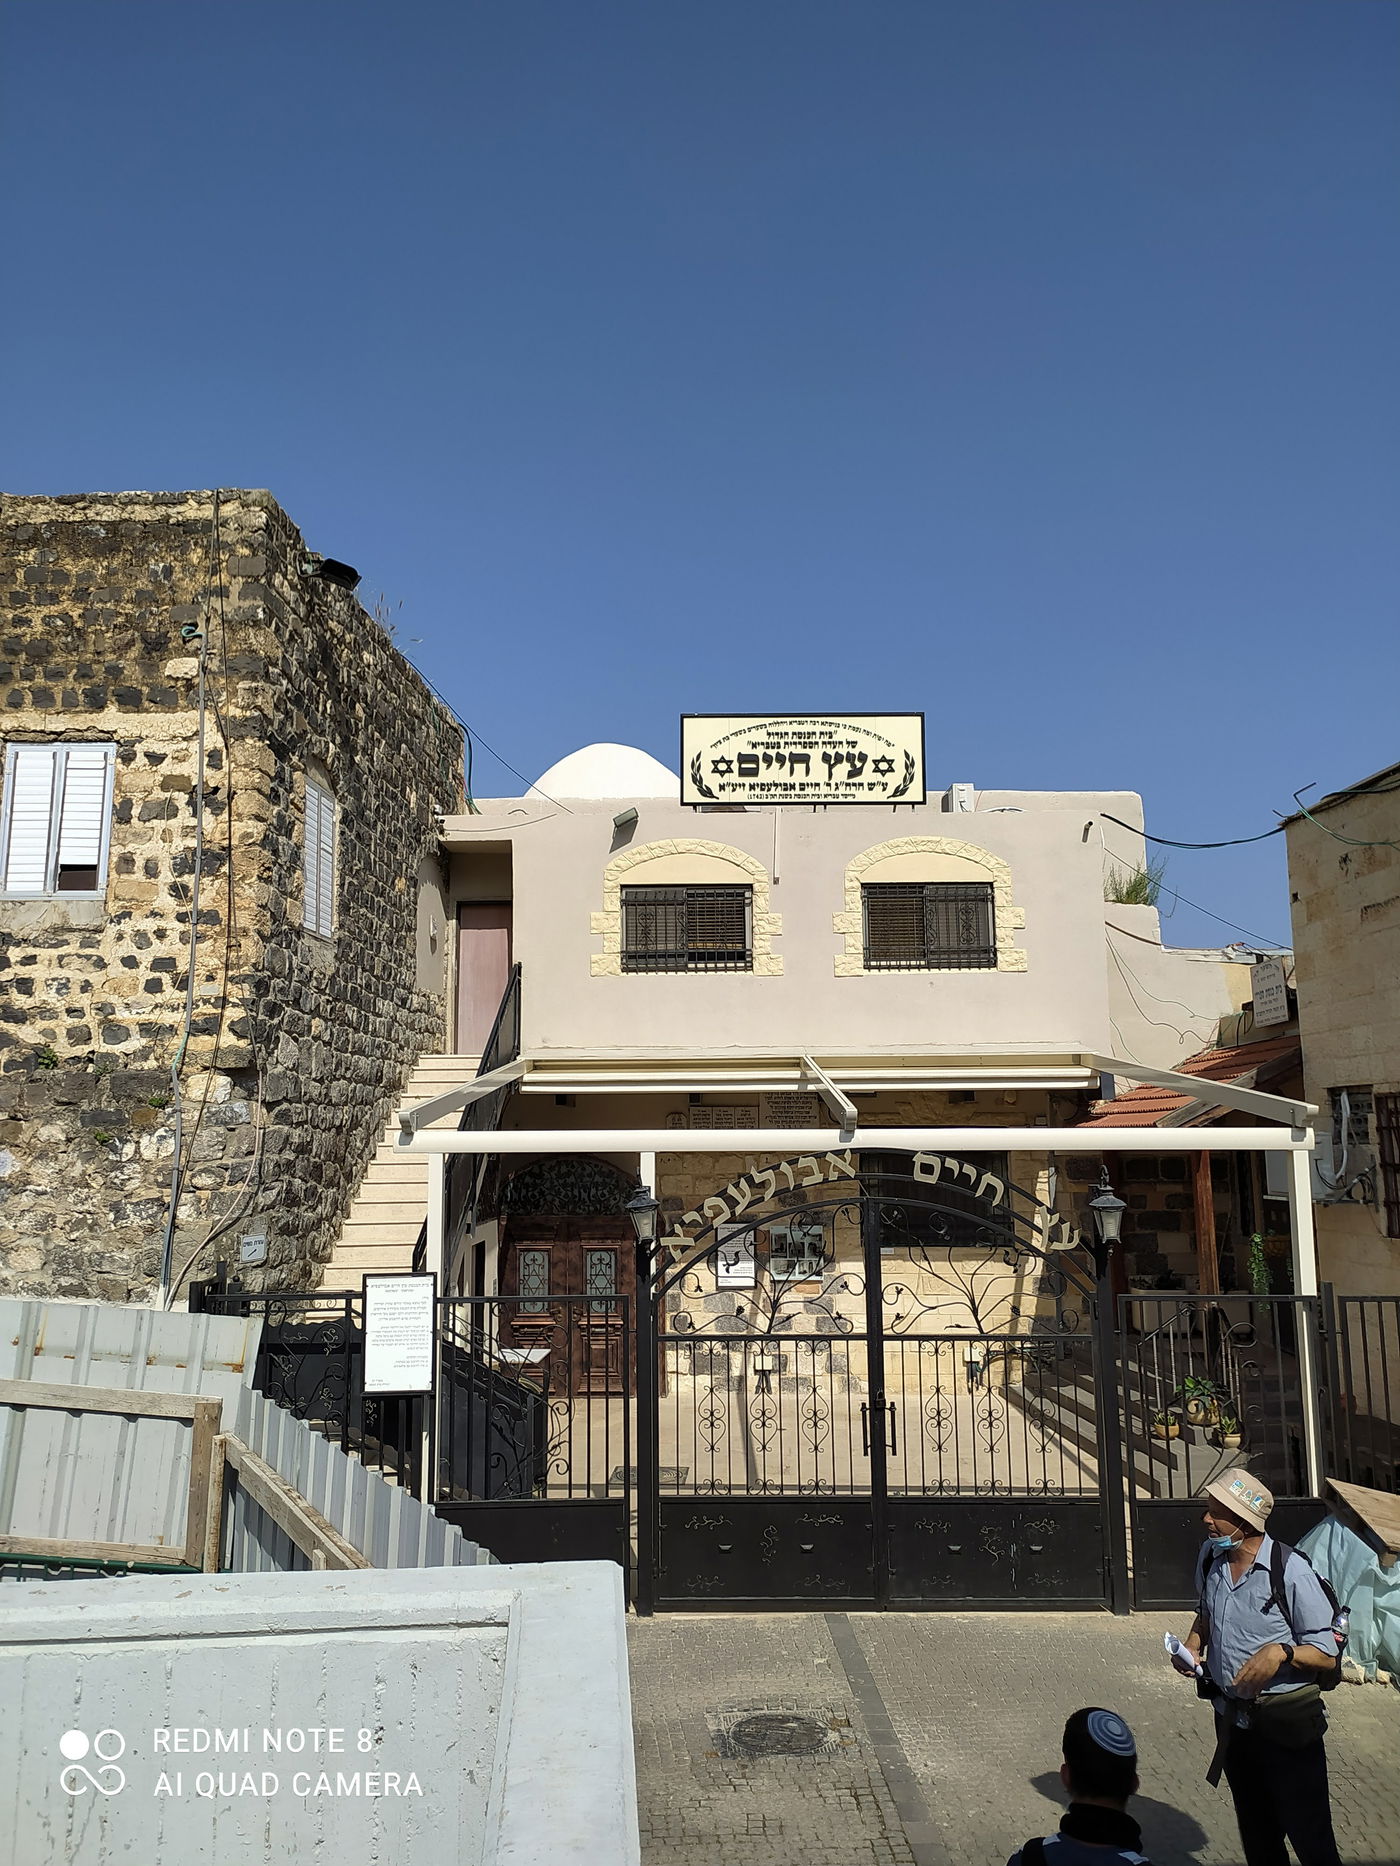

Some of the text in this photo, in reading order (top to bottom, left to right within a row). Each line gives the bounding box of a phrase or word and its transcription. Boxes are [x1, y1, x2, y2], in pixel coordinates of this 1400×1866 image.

[766, 729, 789, 740] הגדול
[791, 731, 816, 740] הכנסת
[784, 741, 819, 749] הספרדית
[822, 741, 844, 749] העדה
[846, 738, 858, 748] של
[736, 751, 868, 781] עץ חיים
[749, 780, 796, 792] אבולעפיא
[798, 782, 820, 791] חיים
[912, 1151, 1004, 1206] חיים
[660, 1148, 857, 1261] אבולעפיא
[1038, 1206, 1081, 1251] עץ
